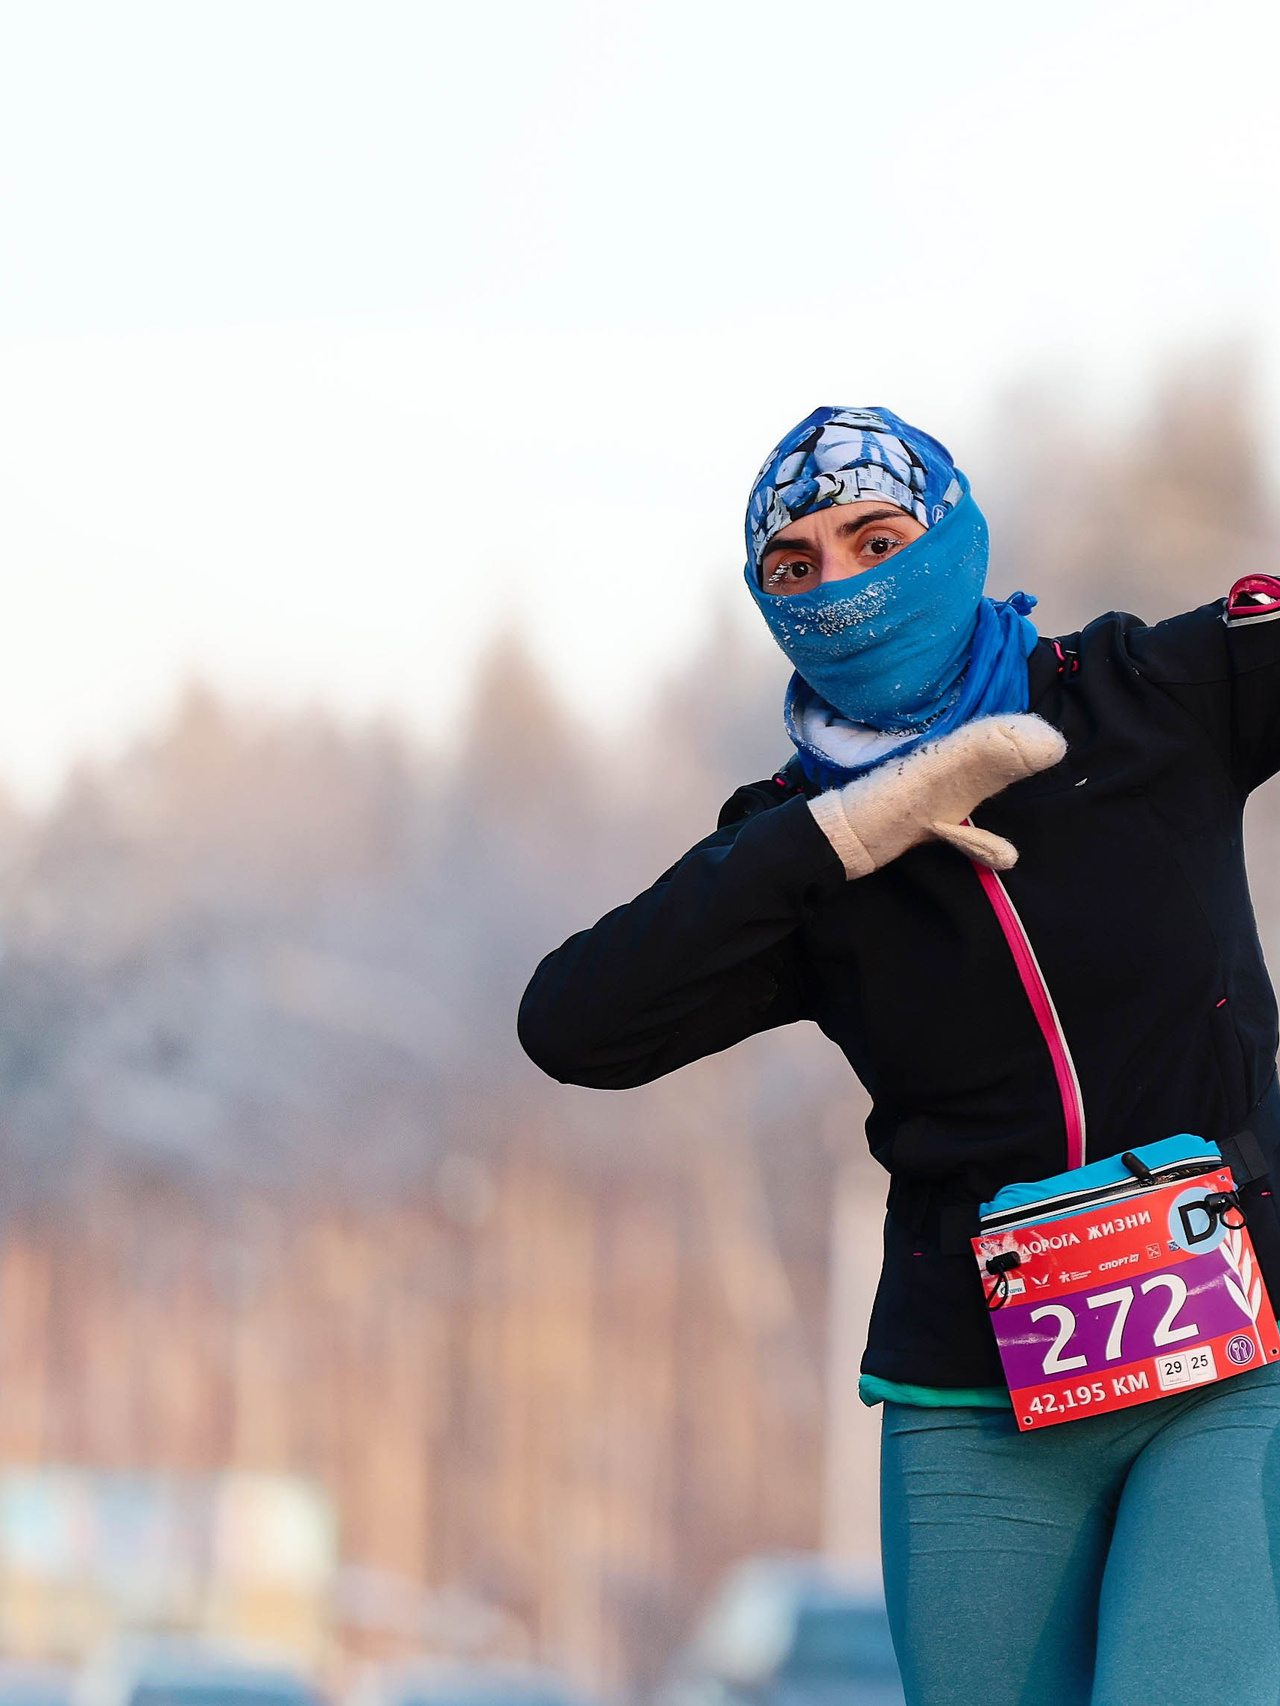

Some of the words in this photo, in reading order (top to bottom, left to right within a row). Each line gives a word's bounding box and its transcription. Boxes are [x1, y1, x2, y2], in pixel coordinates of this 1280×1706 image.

[1019, 1232, 1081, 1255] ДОРОГА
[1086, 1210, 1152, 1240] ЖИЗНИ
[1029, 1273, 1200, 1375] 272
[1164, 1361, 1182, 1375] 29
[1190, 1354, 1208, 1370] 25
[1029, 1382, 1106, 1415] 42,195
